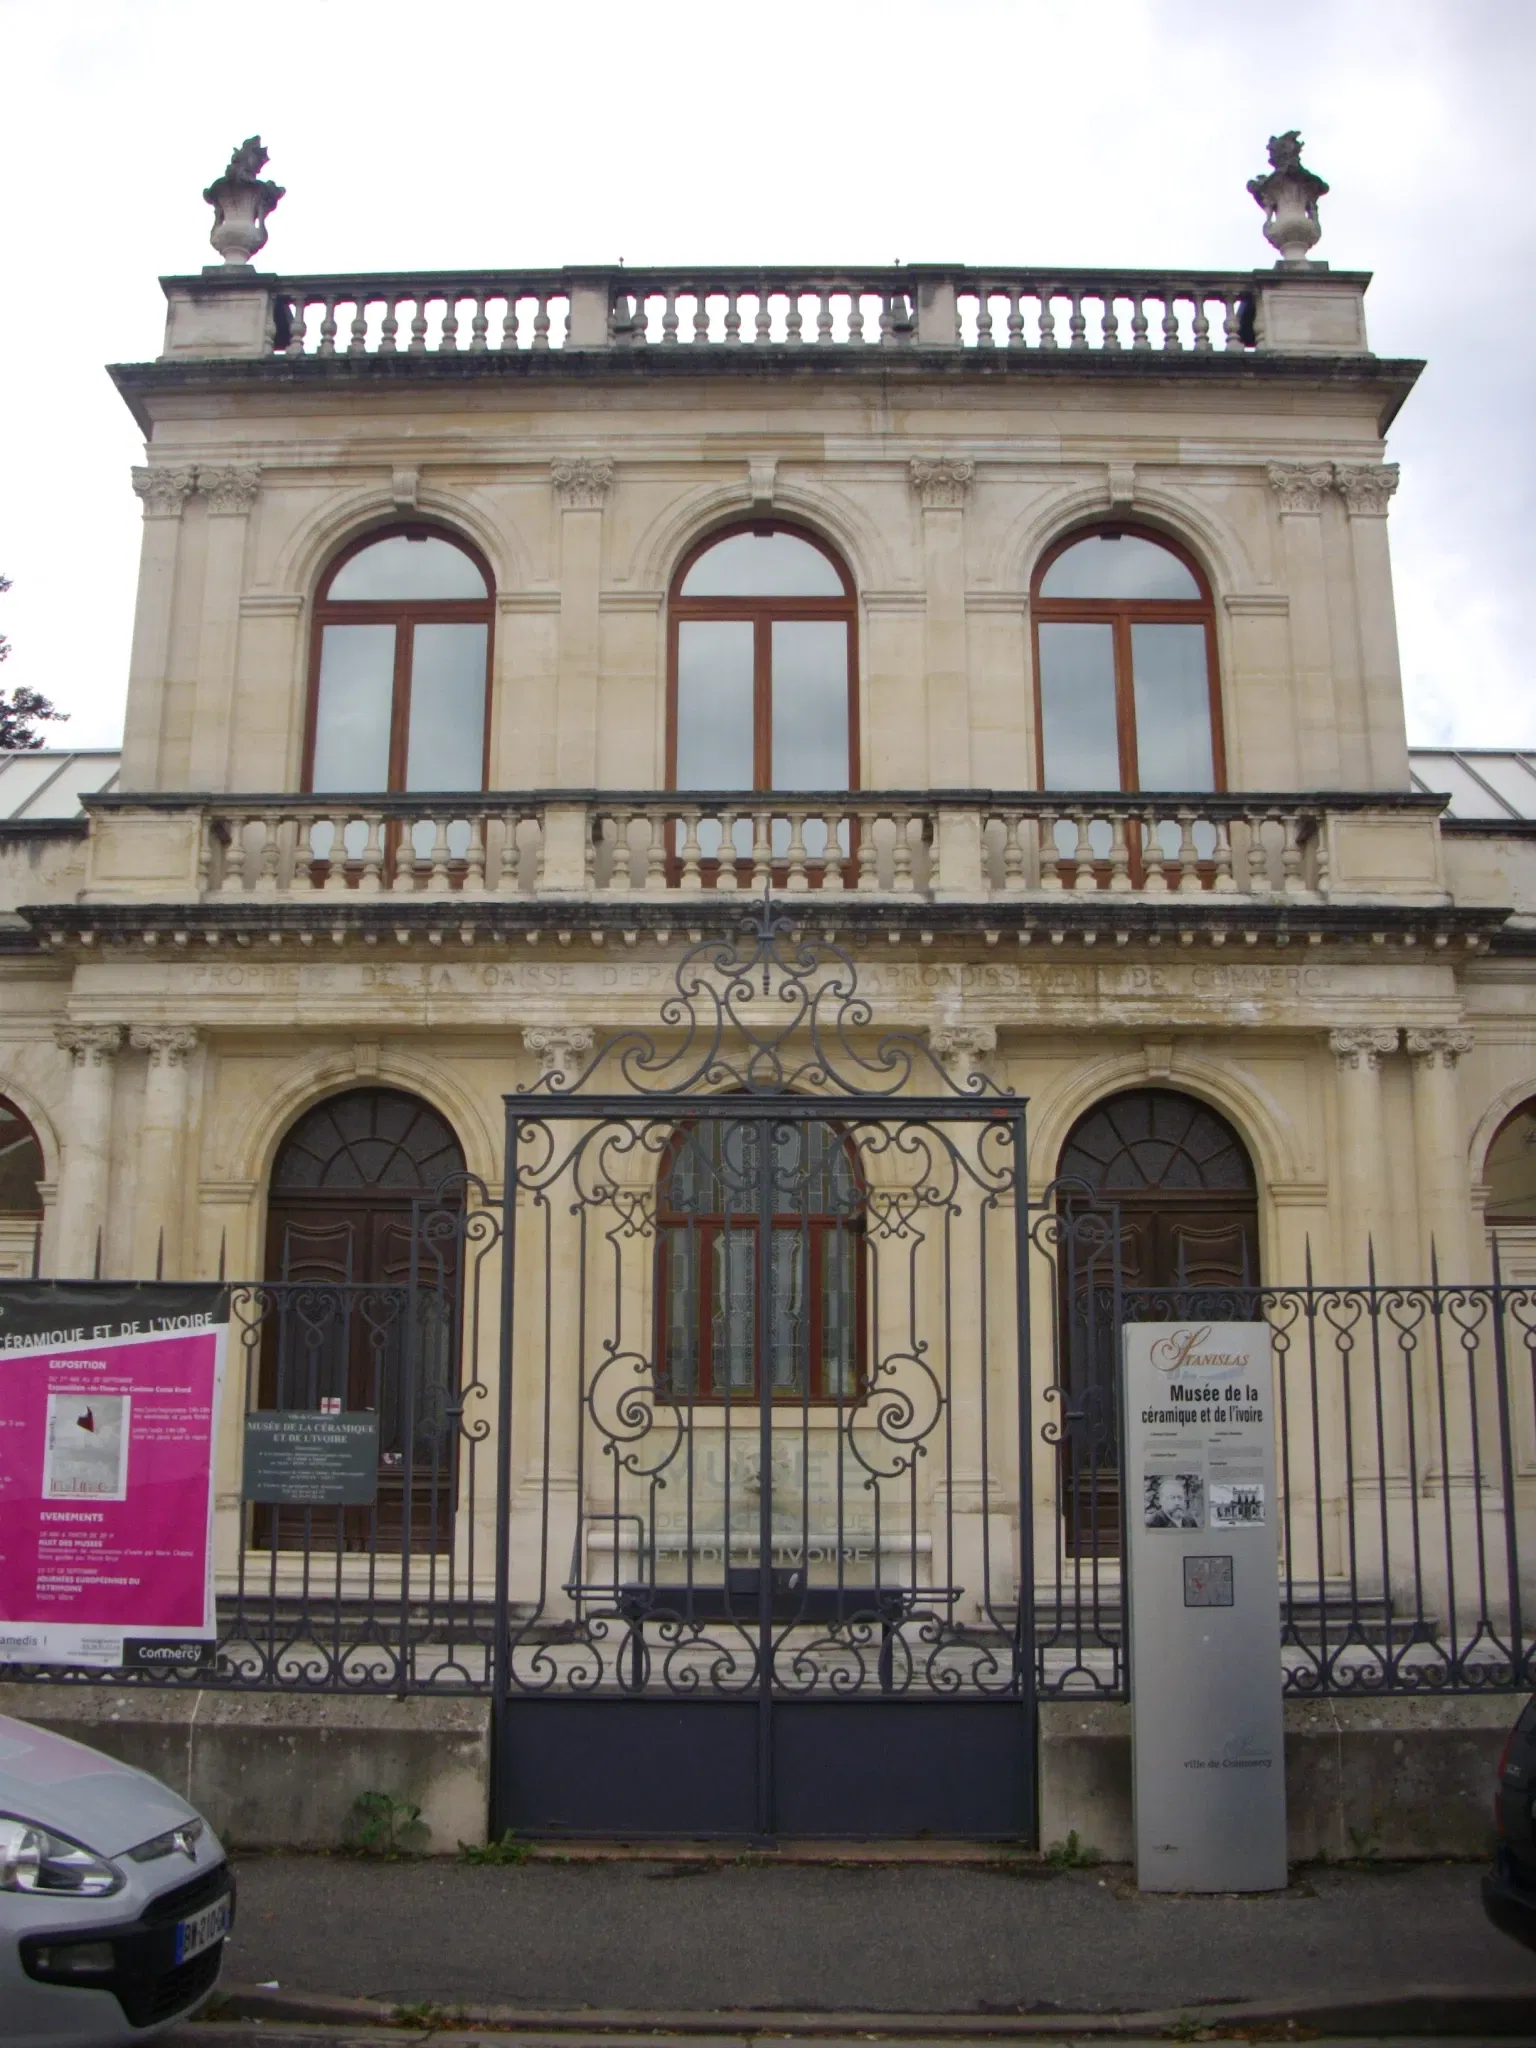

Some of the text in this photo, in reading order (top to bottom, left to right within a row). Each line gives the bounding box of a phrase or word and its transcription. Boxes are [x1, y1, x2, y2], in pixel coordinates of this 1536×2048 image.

[1132, 967, 1165, 988] DE
[1191, 967, 1335, 989] COMMERCY
[92, 1324, 112, 1340] ET
[121, 1321, 140, 1336] DE
[149, 1311, 213, 1334] L'IVOIRE
[48, 1360, 107, 1370] EXPOSITION
[1170, 1383, 1259, 1402] Musée de la
[1141, 1405, 1263, 1428] céramique et de l'ivoire
[247, 1421, 376, 1435] MUSÉE DE LA CÉRAMIQUE
[273, 1434, 348, 1444] ET DE L'IVOIRE
[40, 1512, 104, 1522] EVENEMENTS
[655, 1547, 871, 1565] ET DE LIVOIRE
[138, 1646, 203, 1661] Commercy
[1183, 1759, 1206, 1769] ville
[1221, 1758, 1273, 1769] Commercy
